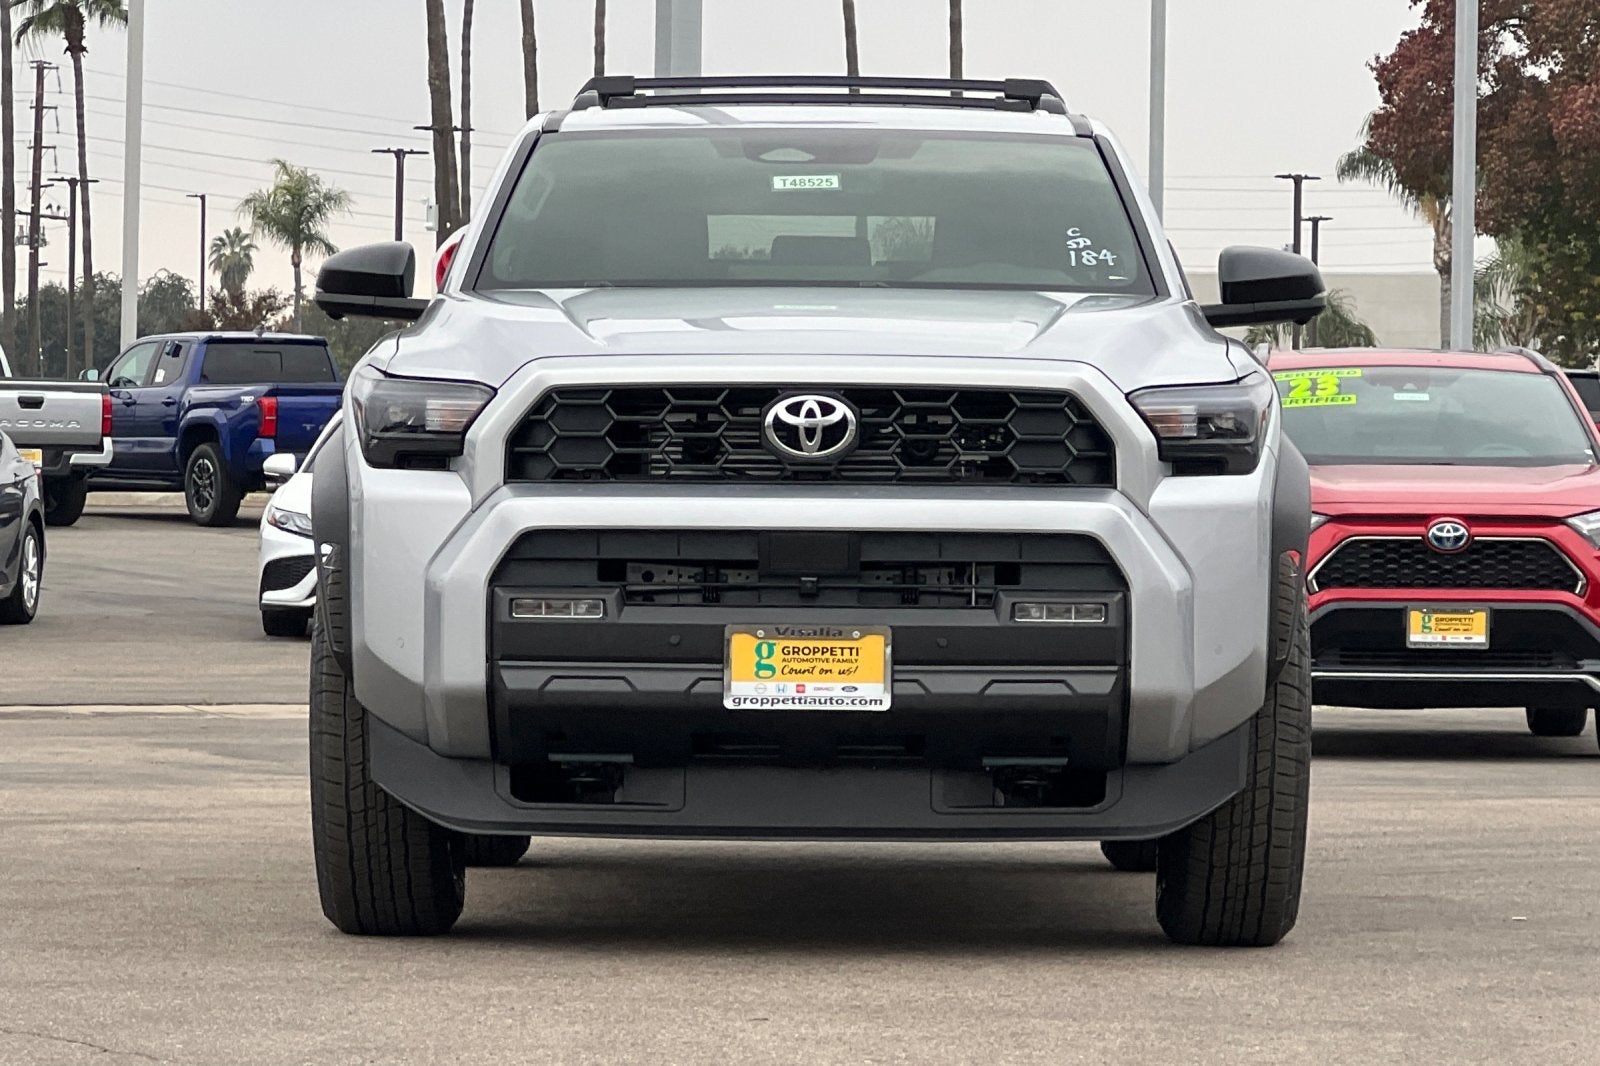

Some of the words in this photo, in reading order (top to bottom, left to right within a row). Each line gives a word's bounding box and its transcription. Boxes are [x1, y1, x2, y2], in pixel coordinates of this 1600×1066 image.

[779, 178, 834, 187] T48525
[1069, 249, 1117, 267] 184
[1274, 370, 1358, 379] CERTIFIED
[1288, 375, 1341, 398] 23
[1281, 396, 1353, 405] ERTIFIED
[0, 420, 81, 428] ACOMA
[774, 626, 844, 637] Visalia
[781, 645, 860, 657] GROPPETTI
[781, 664, 816, 676] Count
[818, 667, 833, 675] on
[837, 665, 859, 676] us!
[731, 695, 883, 707] groppettiauto.com
